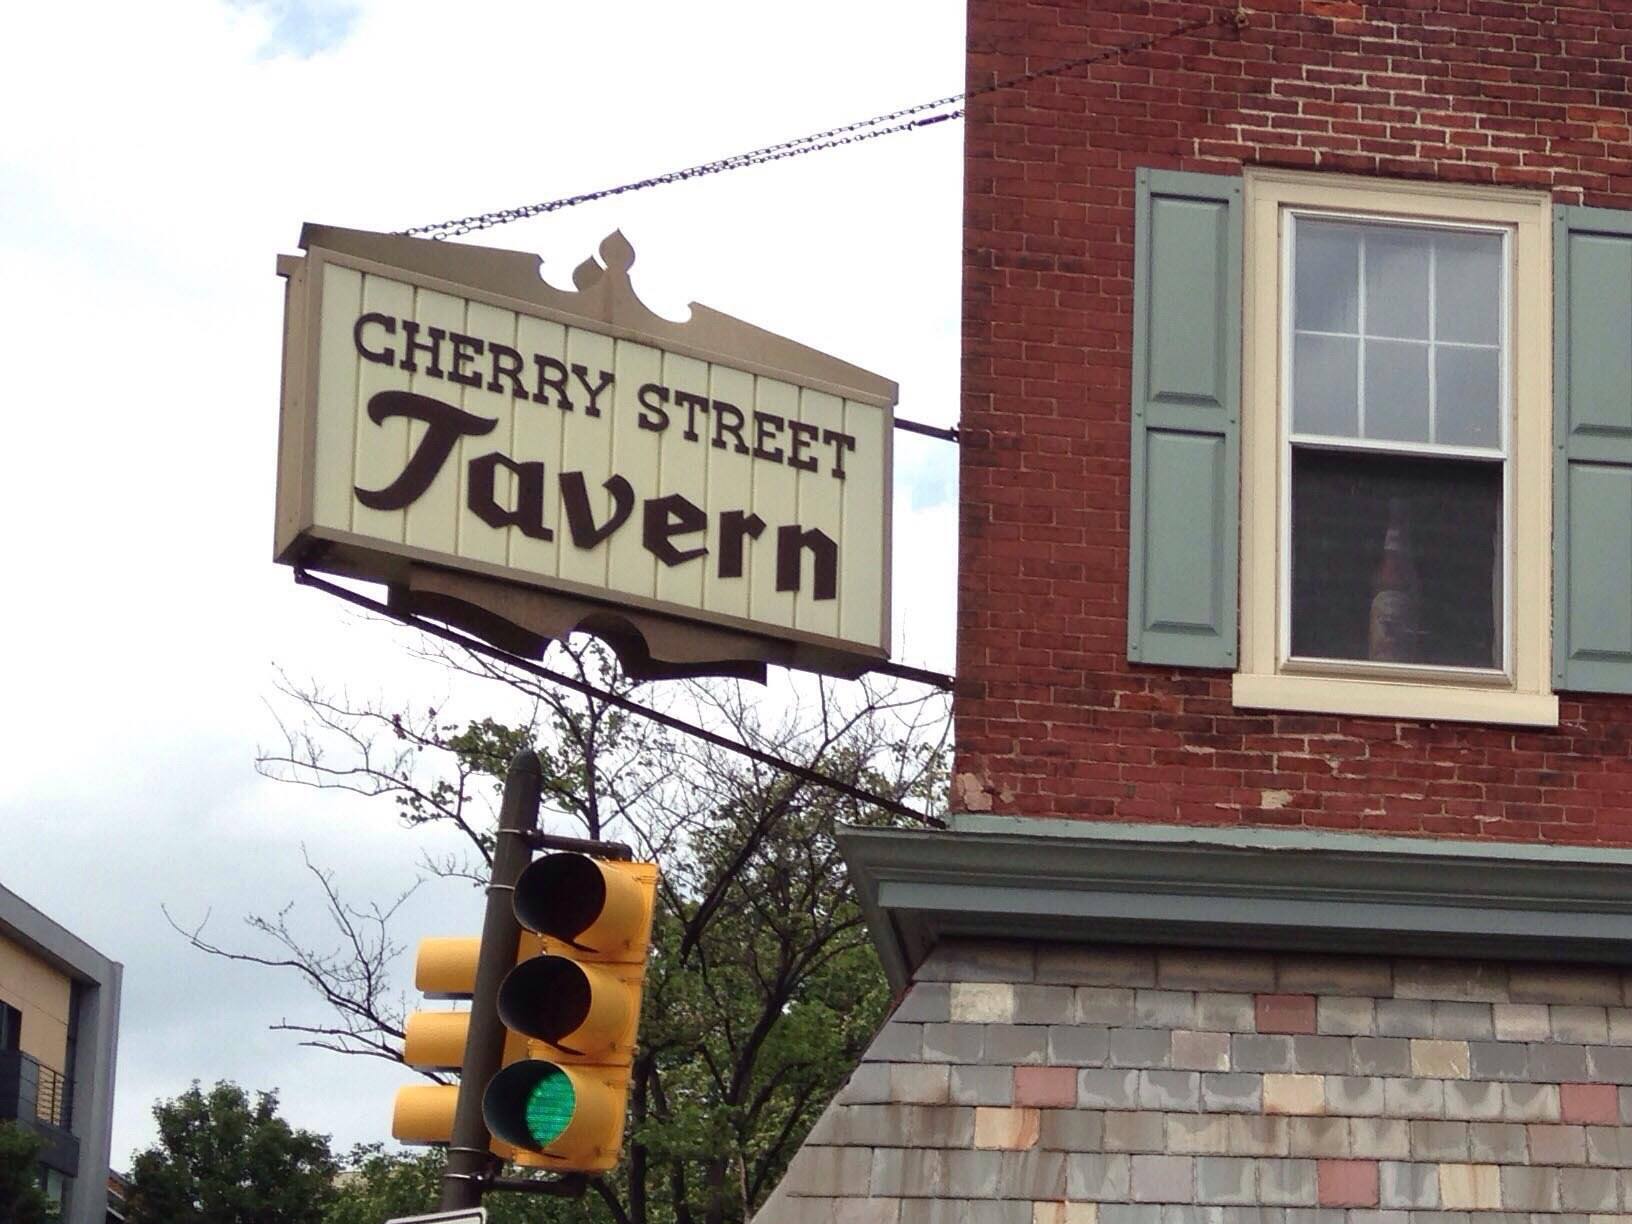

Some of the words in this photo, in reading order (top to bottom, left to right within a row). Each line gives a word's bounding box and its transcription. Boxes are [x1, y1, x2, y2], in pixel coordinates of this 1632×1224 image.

[354, 312, 616, 418] CHERRY
[637, 382, 856, 480] STREET
[353, 390, 838, 601] Tavern
